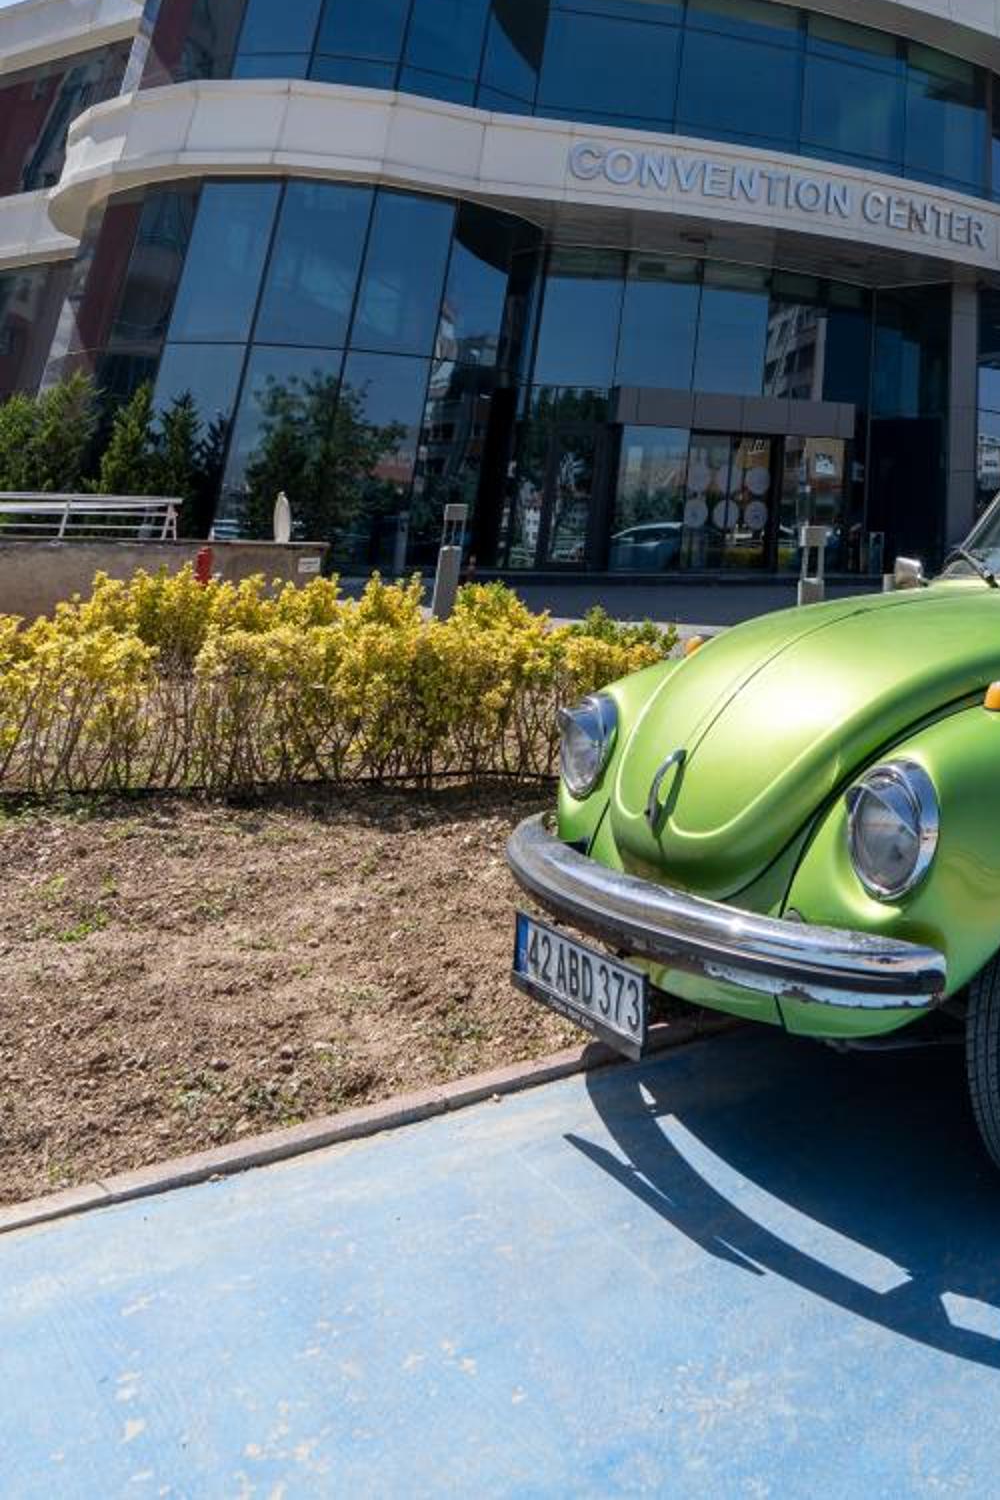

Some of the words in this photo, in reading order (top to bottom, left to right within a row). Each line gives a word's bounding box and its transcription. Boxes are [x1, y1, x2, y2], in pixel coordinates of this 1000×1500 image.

[569, 141, 853, 220] CONVENTION
[862, 190, 988, 251] CENTER
[528, 930, 552, 982] 42
[556, 943, 593, 1003] ABD
[598, 964, 641, 1033] 373
